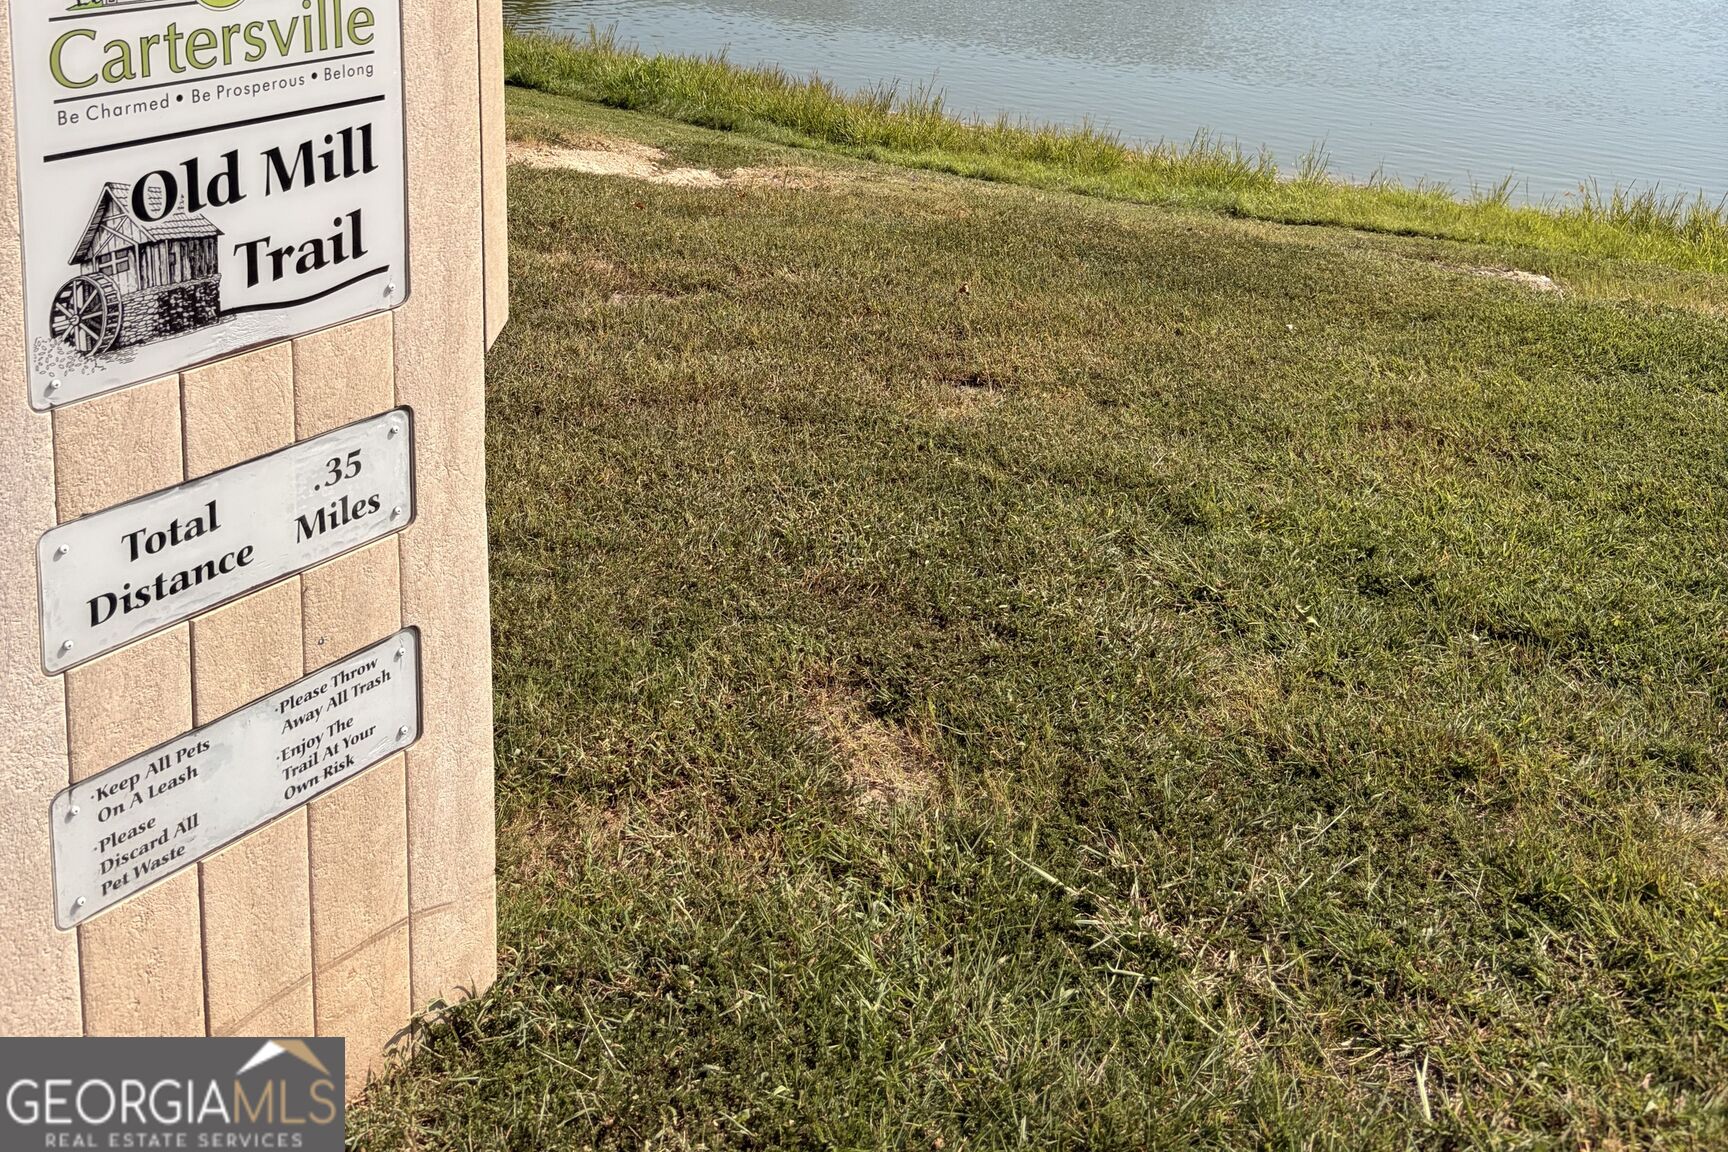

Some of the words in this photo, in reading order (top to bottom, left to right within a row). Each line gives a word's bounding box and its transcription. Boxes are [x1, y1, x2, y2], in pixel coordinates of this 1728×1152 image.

[57, 110, 79, 126] Be
[86, 94, 169, 121] Charmed
[192, 88, 211, 104] Be
[217, 74, 305, 102] Prosperous
[324, 63, 374, 81] Belong
[132, 149, 247, 222] Old
[261, 123, 378, 196] Mill
[233, 208, 368, 288] Trail
[314, 450, 361, 491] .35
[121, 500, 221, 562] Total
[294, 494, 380, 544] Miles
[86, 545, 254, 627] Distance
[279, 684, 328, 714] Please
[331, 658, 379, 689] Throw
[282, 706, 323, 734] Away
[327, 689, 348, 712] All
[352, 669, 391, 698] Trash
[281, 733, 323, 761] Enjoy
[326, 717, 354, 736] The
[282, 752, 319, 780] Trail
[323, 743, 340, 761] At
[342, 725, 376, 750] Your
[97, 774, 140, 801] Keep
[145, 754, 171, 779] All
[176, 739, 210, 764] Pets
[98, 803, 125, 823] On
[129, 792, 144, 809] A
[149, 766, 199, 798] Leash
[284, 776, 320, 800] Own
[323, 754, 354, 780] Risk
[99, 816, 156, 853] Please
[100, 833, 169, 875] Discard
[173, 813, 200, 840] All
[102, 873, 128, 896] Pet
[133, 845, 185, 881] Waste
